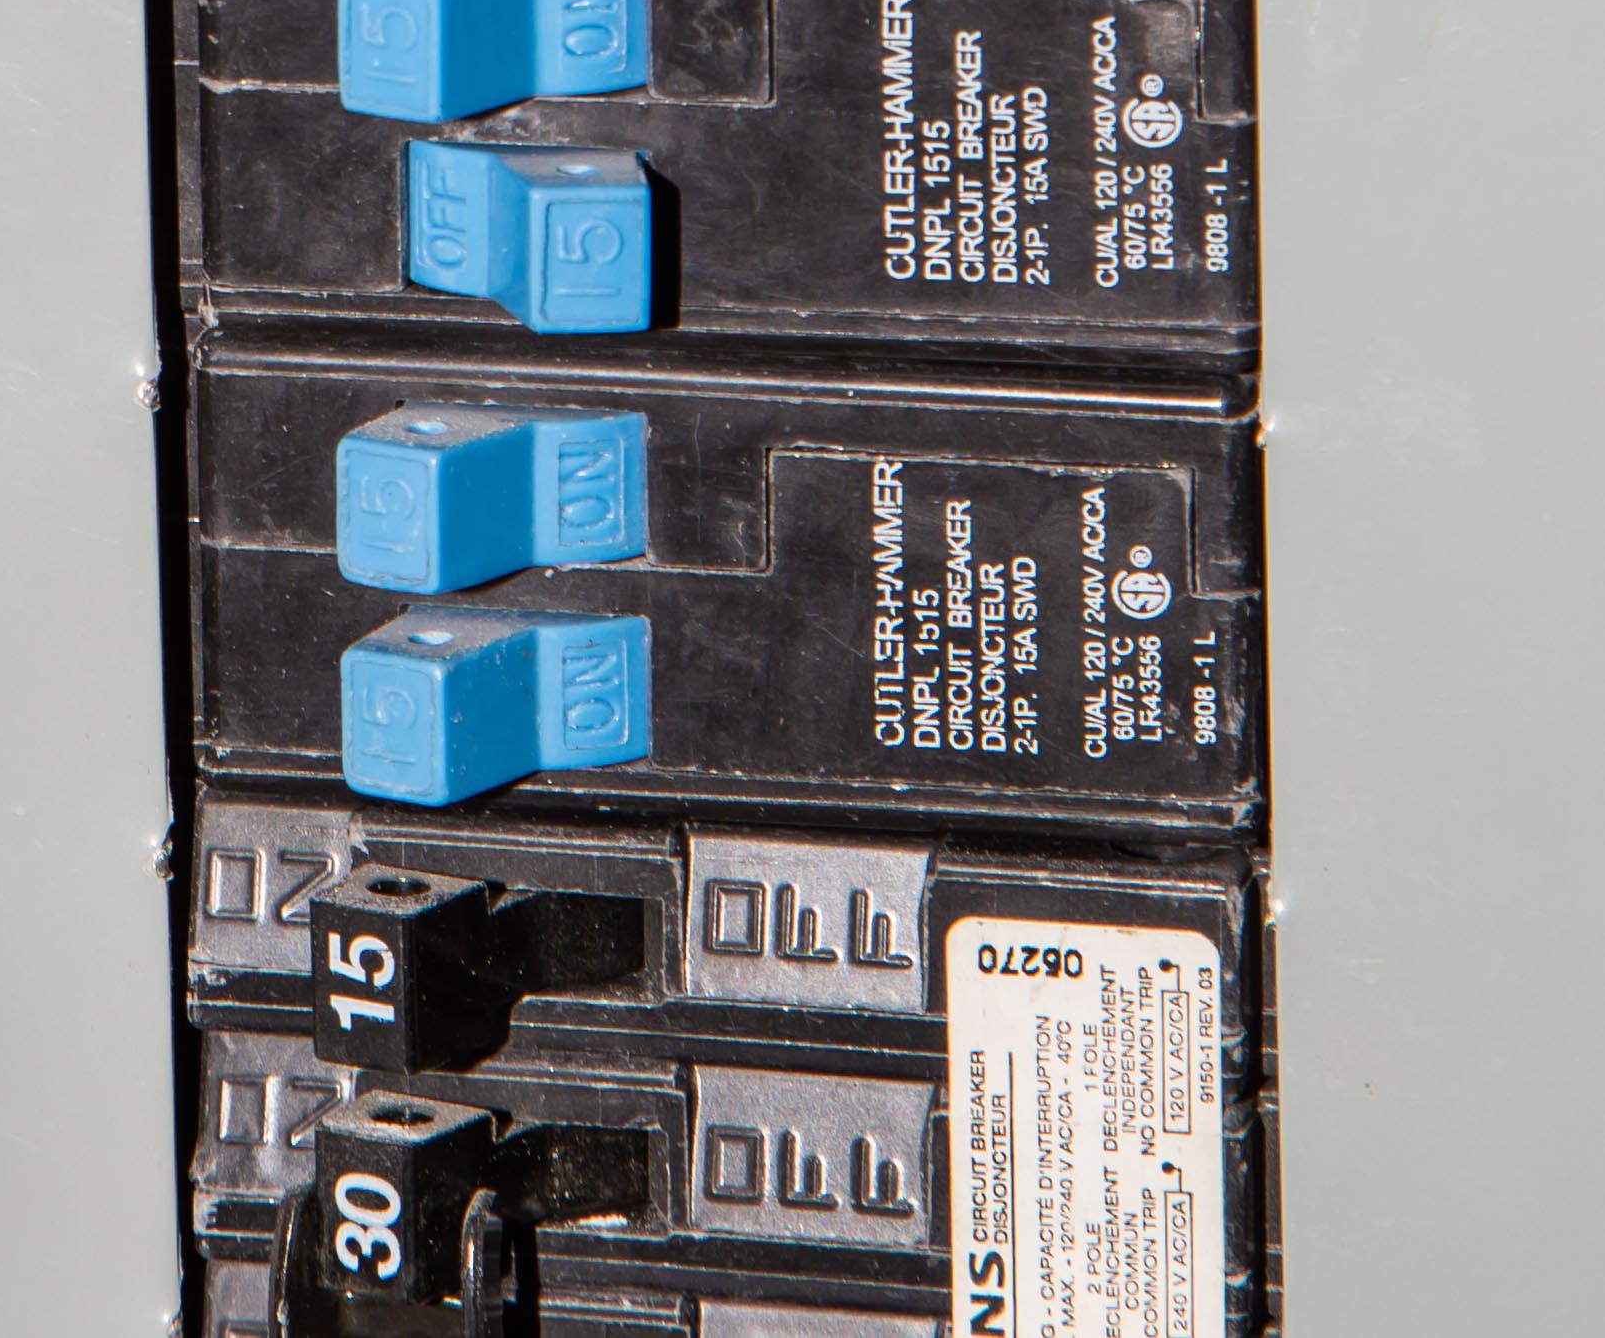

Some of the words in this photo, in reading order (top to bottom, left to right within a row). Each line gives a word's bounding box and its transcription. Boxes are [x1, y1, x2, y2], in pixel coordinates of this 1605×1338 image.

[955, 31, 984, 159] BREAKER
[1022, 86, 1049, 152] SWD
[922, 120, 951, 188] 1515
[989, 94, 1018, 283] DISJONCTEUR
[1023, 157, 1049, 205] 15A
[426, 164, 468, 270] OFF
[555, 219, 624, 297] 15
[922, 198, 955, 281] DNPL
[958, 174, 985, 282] CIRCUIT
[1123, 203, 1147, 270] 60/75
[1149, 163, 1174, 270] LR43556
[559, 451, 615, 528] ON
[872, 461, 905, 747] CUTLER-HAMMER
[945, 500, 973, 628] BREAKER
[1012, 556, 1038, 621] SWD
[912, 589, 940, 656] 1515
[979, 563, 1007, 752] DISJONCTEUR
[1013, 627, 1038, 675] 15A
[563, 653, 619, 732] ON
[912, 666, 941, 748] DNPL
[947, 642, 974, 750] CIRCUIT
[1112, 674, 1135, 740] 60/75
[1138, 635, 1163, 742] LR43556
[325, 928, 395, 1033] 15
[1137, 966, 1153, 1010] TRIP
[970, 1050, 986, 1151] BREAKER
[1035, 1015, 1053, 1190] D'INTERRUPTION
[1119, 986, 1136, 1134] INDEPENDANT
[1139, 1018, 1155, 1118] COMMON
[991, 1094, 1008, 1244] DISJONCTEUR
[1140, 1125, 1155, 1156] NO
[331, 1172, 400, 1283] 30
[971, 1156, 988, 1243] CIRCUIT
[1036, 1197, 1055, 1300] CAPACITÉ
